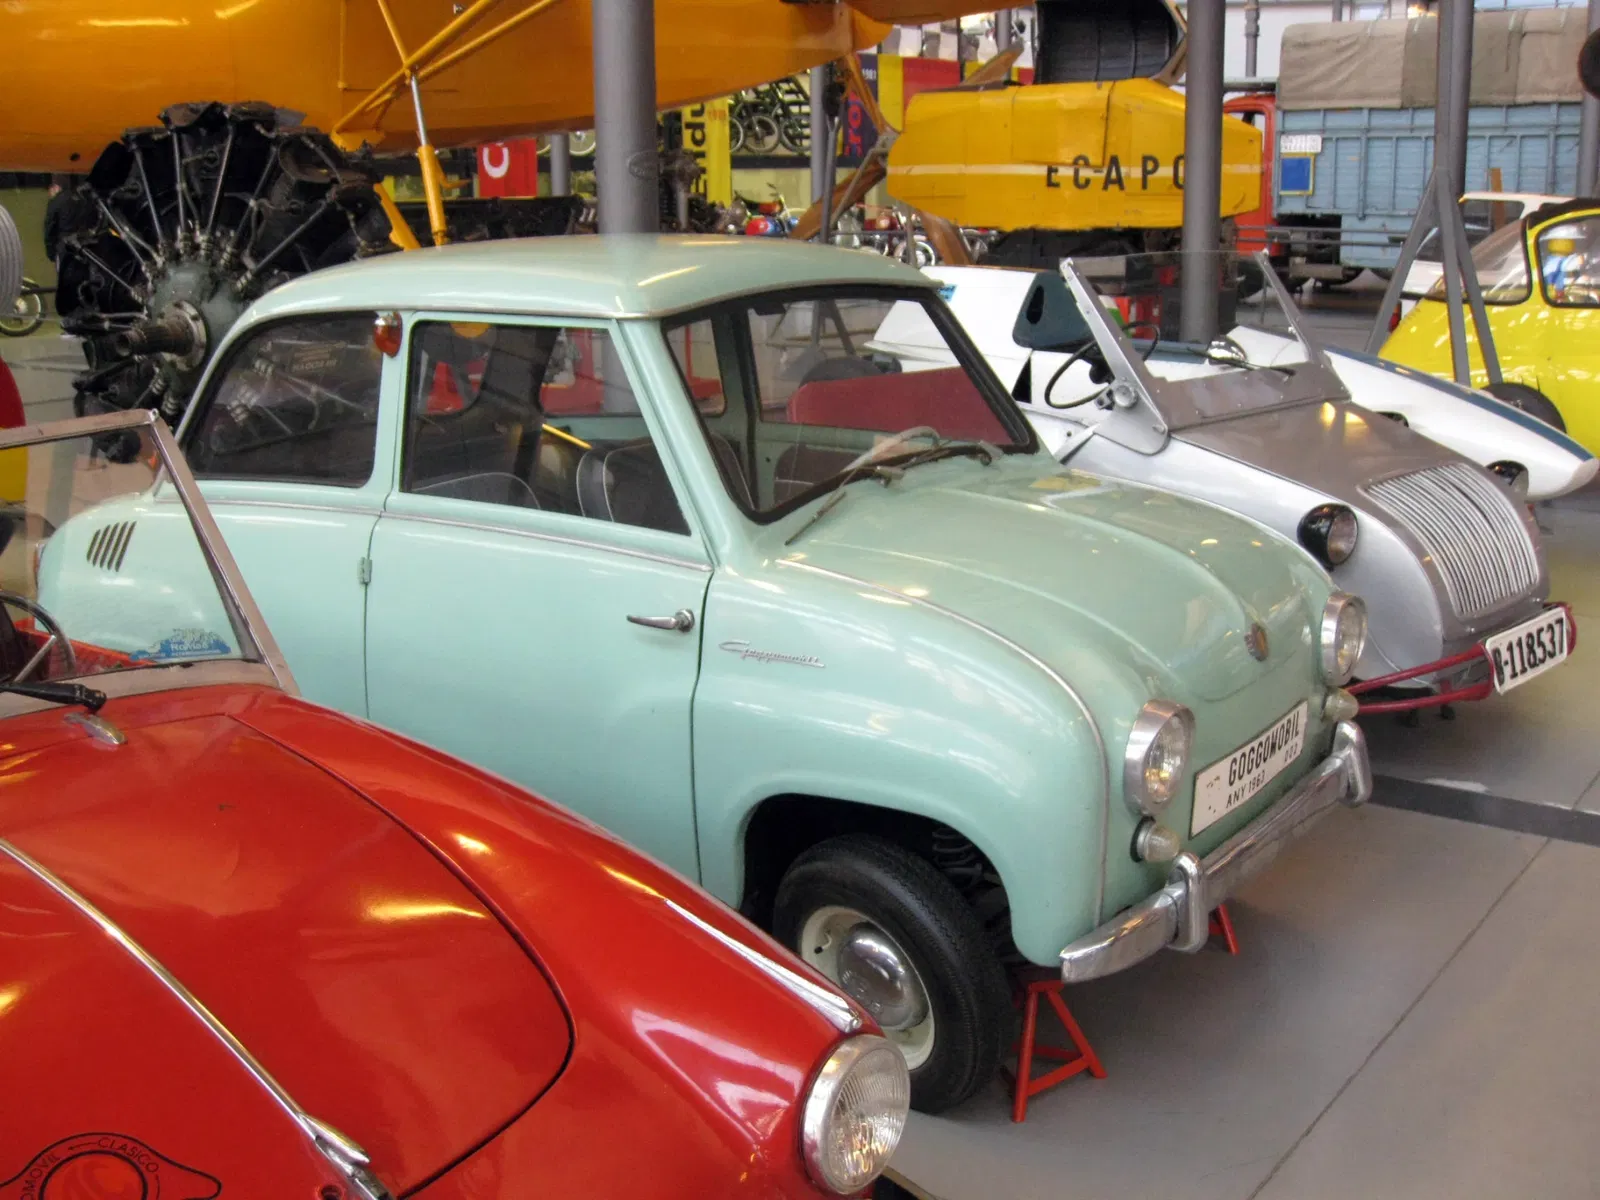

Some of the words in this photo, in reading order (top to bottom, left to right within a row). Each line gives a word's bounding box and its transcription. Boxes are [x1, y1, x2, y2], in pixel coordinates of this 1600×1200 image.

[1228, 710, 1300, 788] GOGGOMOBIL
[1225, 783, 1247, 809] ANY
[98, 1137, 160, 1174] CLASICO
